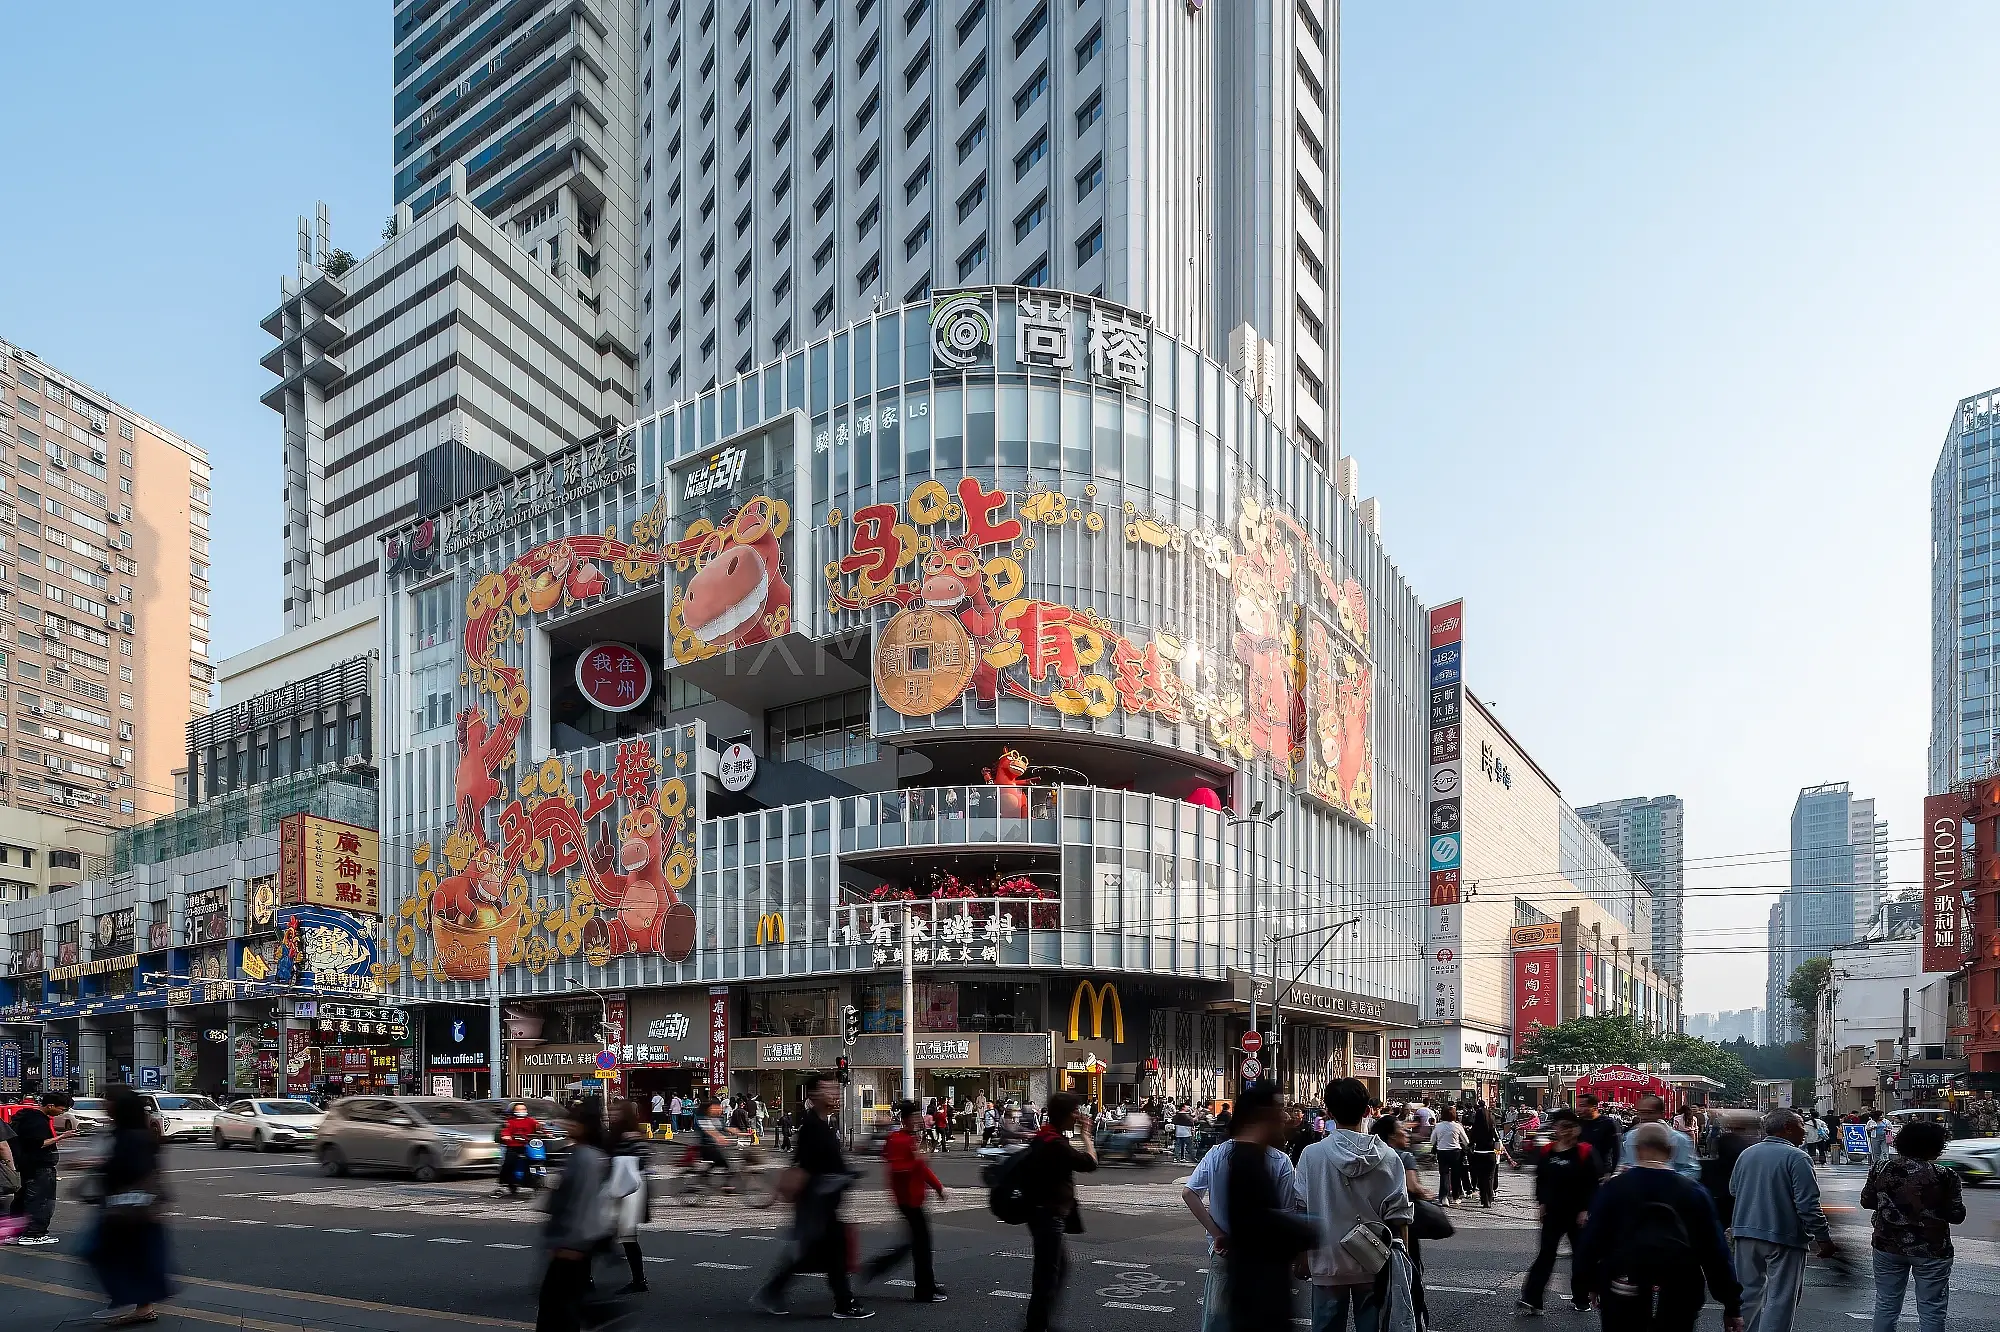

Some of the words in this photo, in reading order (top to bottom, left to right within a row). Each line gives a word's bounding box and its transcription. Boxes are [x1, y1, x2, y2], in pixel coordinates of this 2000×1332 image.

[1016, 299, 1149, 387] 尚榕
[909, 403, 928, 418] L5
[444, 533, 480, 557] BEIJING
[477, 523, 504, 541] ROAD
[555, 478, 603, 508] TOURISM
[603, 462, 636, 487] ZONE
[840, 477, 1023, 582] 马上
[592, 652, 637, 673] 我在
[592, 677, 636, 699] 广州
[583, 740, 651, 822] 上楼
[499, 800, 580, 876] 马上
[1934, 817, 1956, 892] GOELIA
[334, 831, 362, 904] 廣御點
[186, 916, 204, 944] 3F
[1934, 895, 1955, 947] 歌莉娅
[10, 950, 22, 974] 3F
[1289, 988, 1344, 1012] Mercure
[915, 1040, 970, 1054] 六福珠寶
[1391, 1041, 1408, 1049] UNI
[1391, 1049, 1408, 1057] QLO
[345, 1053, 367, 1065] 便利店
[431, 1053, 451, 1065] luckin
[452, 1053, 474, 1065] coffee
[524, 1053, 553, 1066] MOLLY
[554, 1053, 574, 1065] TEA
[144, 1069, 158, 1082] P
